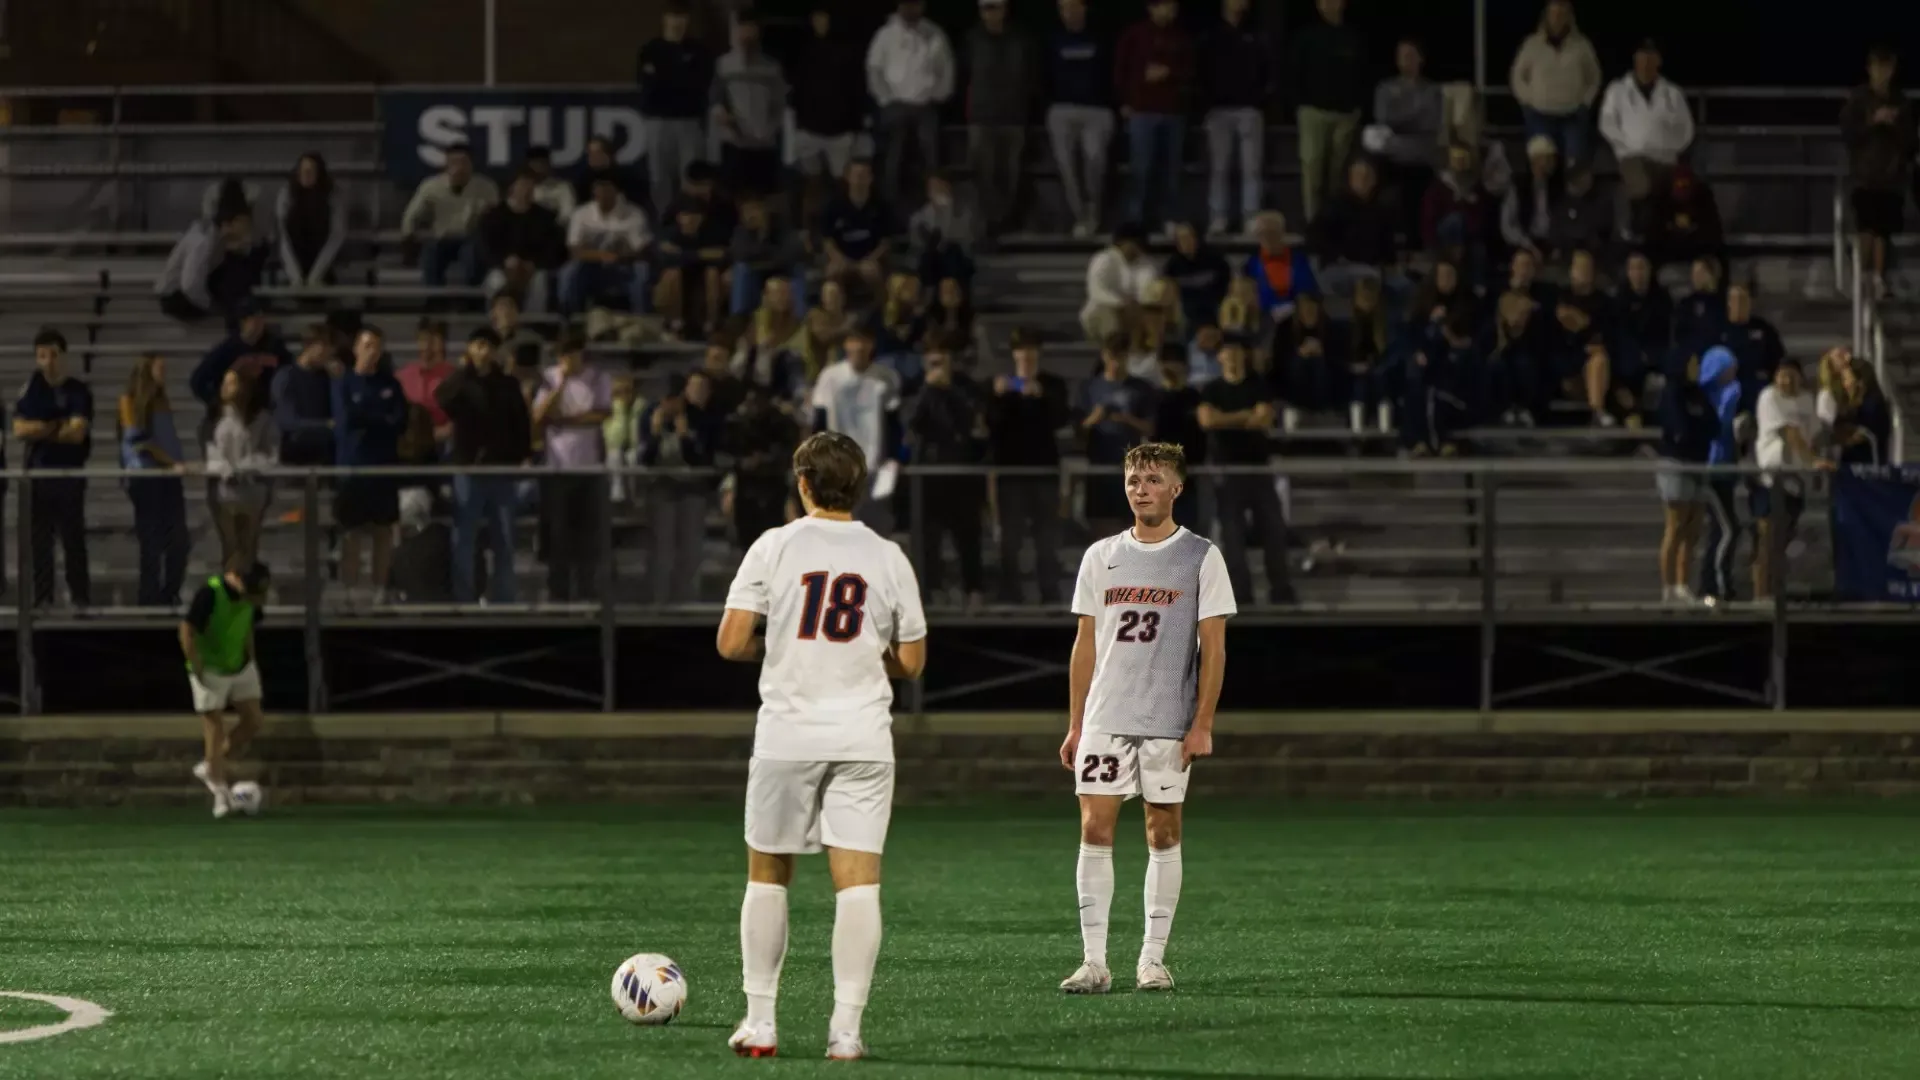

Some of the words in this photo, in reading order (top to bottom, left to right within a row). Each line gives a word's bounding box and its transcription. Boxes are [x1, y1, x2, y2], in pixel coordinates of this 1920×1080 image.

[797, 570, 868, 643] 18
[1104, 586, 1184, 607] WHEATON
[1116, 610, 1161, 642] 23
[1081, 754, 1120, 783] 23
